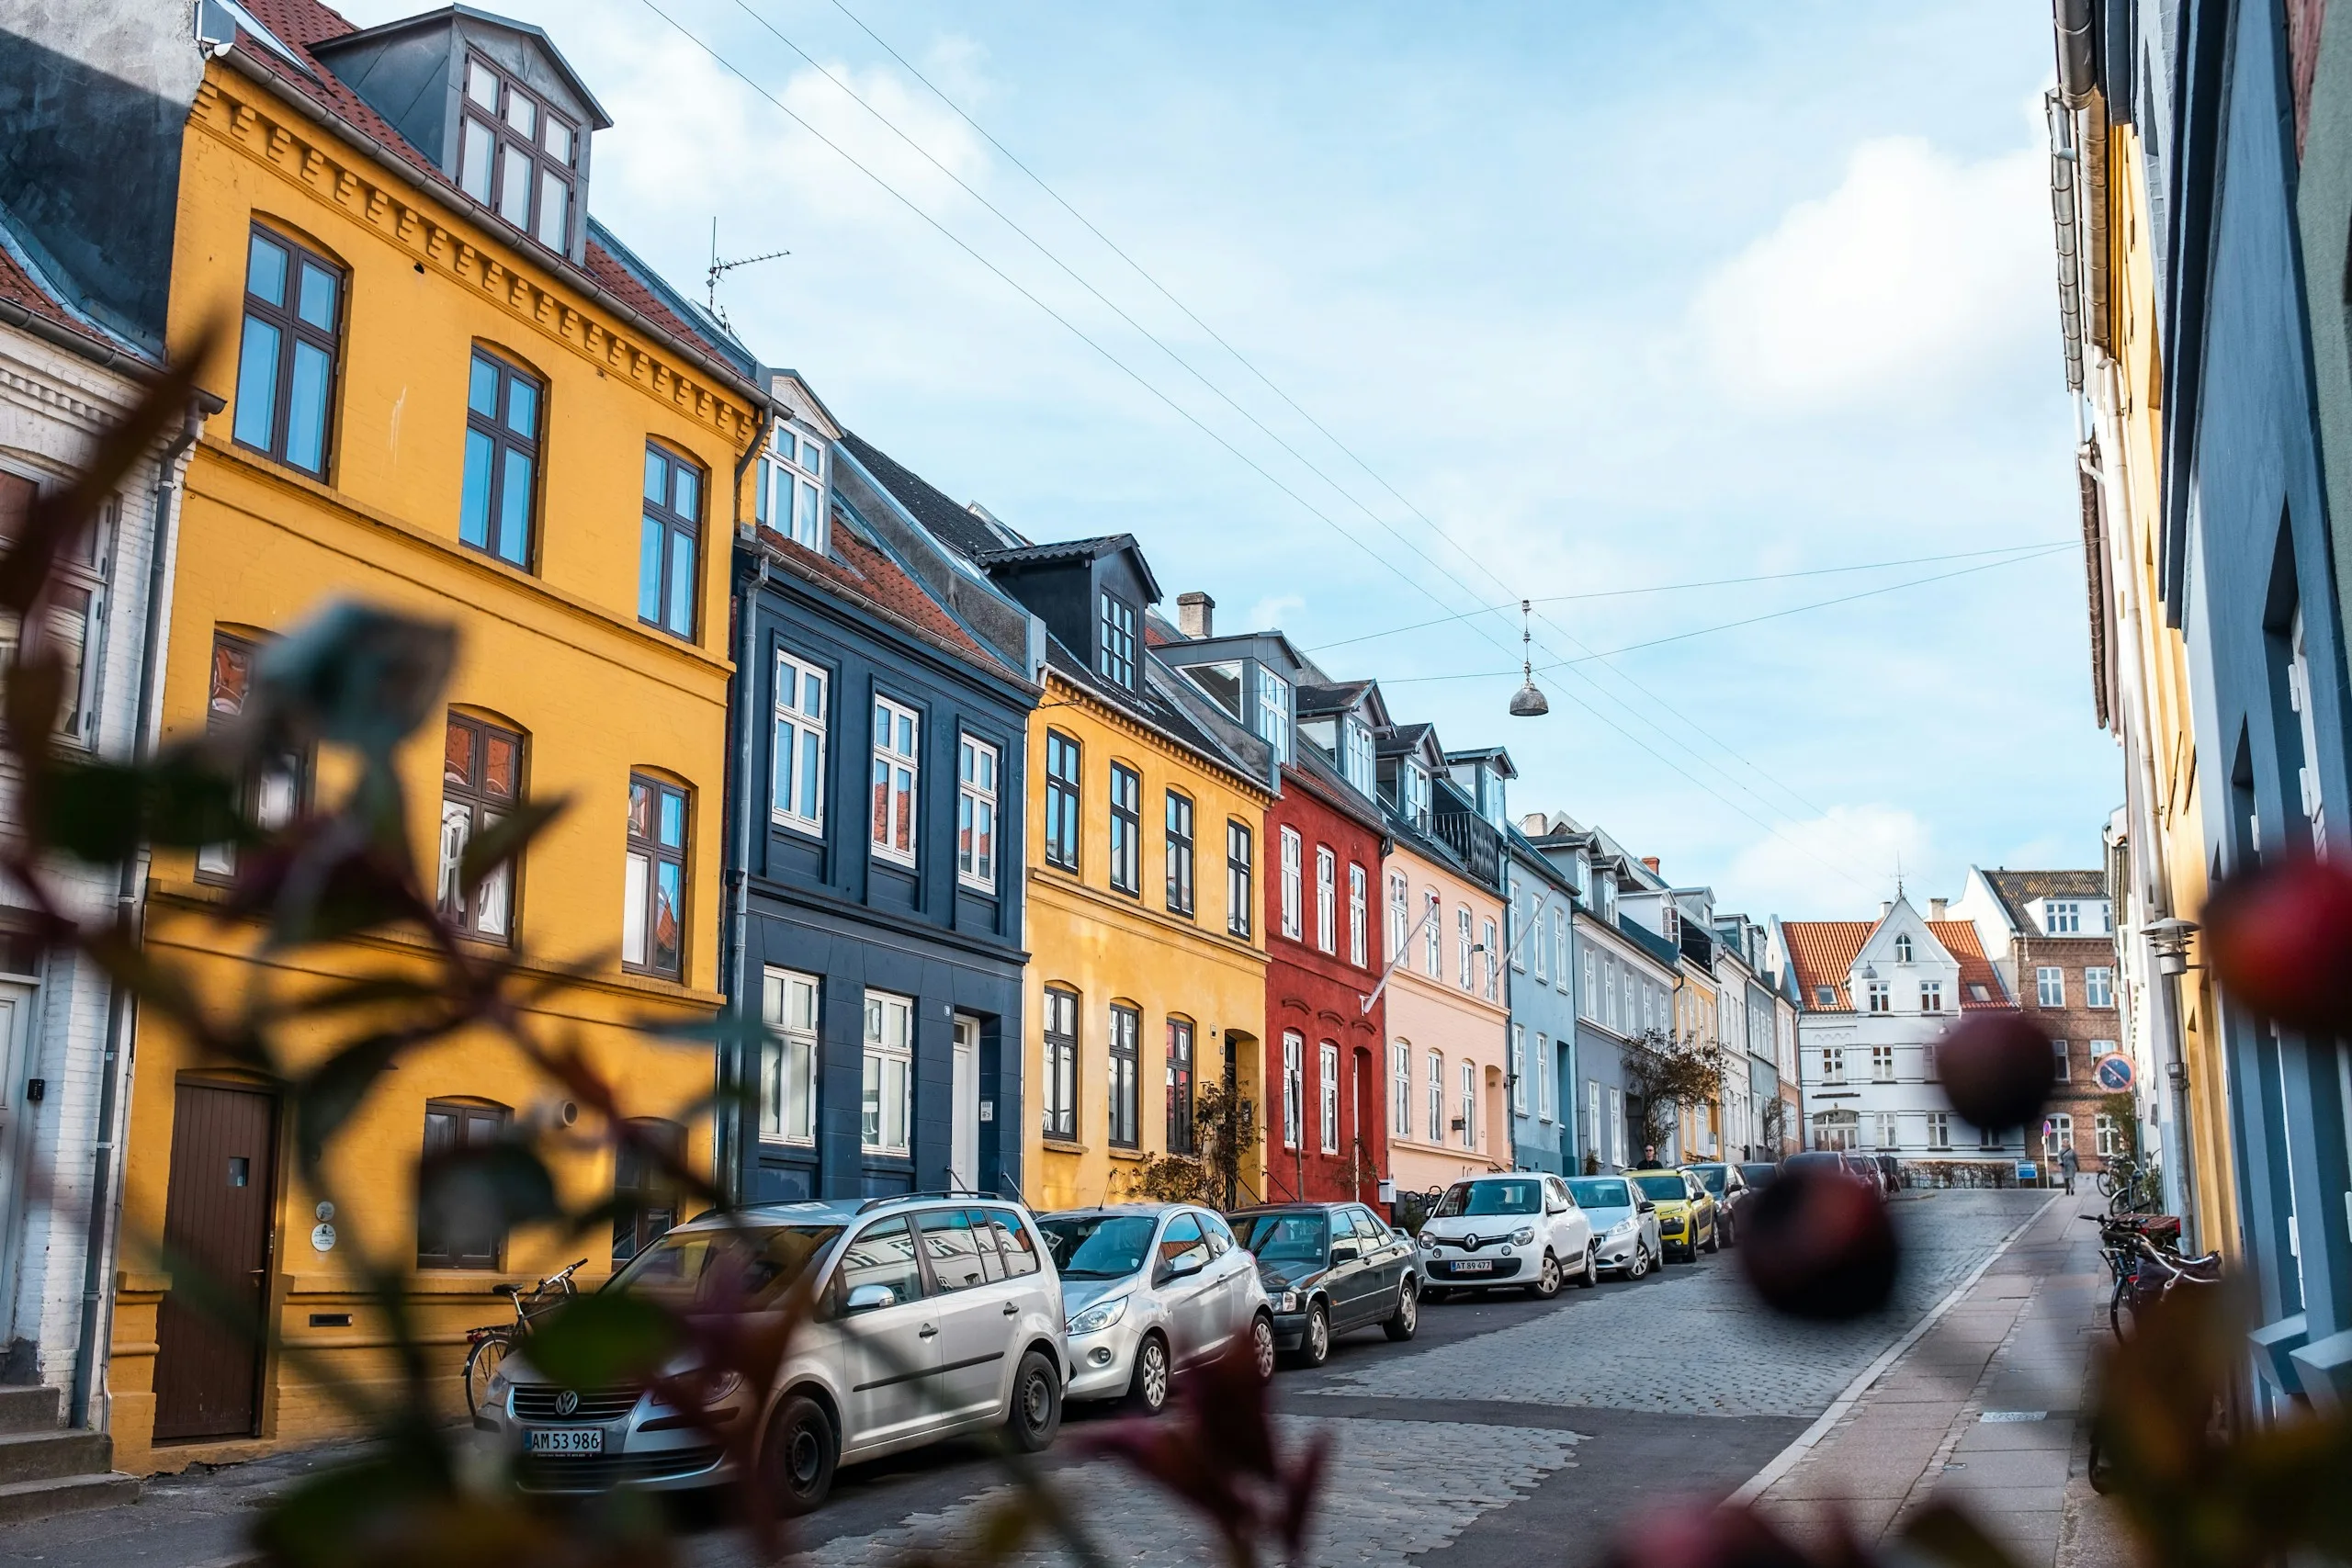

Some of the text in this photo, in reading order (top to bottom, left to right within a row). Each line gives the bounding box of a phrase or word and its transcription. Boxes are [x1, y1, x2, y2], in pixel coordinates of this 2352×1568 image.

[533, 1432, 600, 1449] AM 53 986
